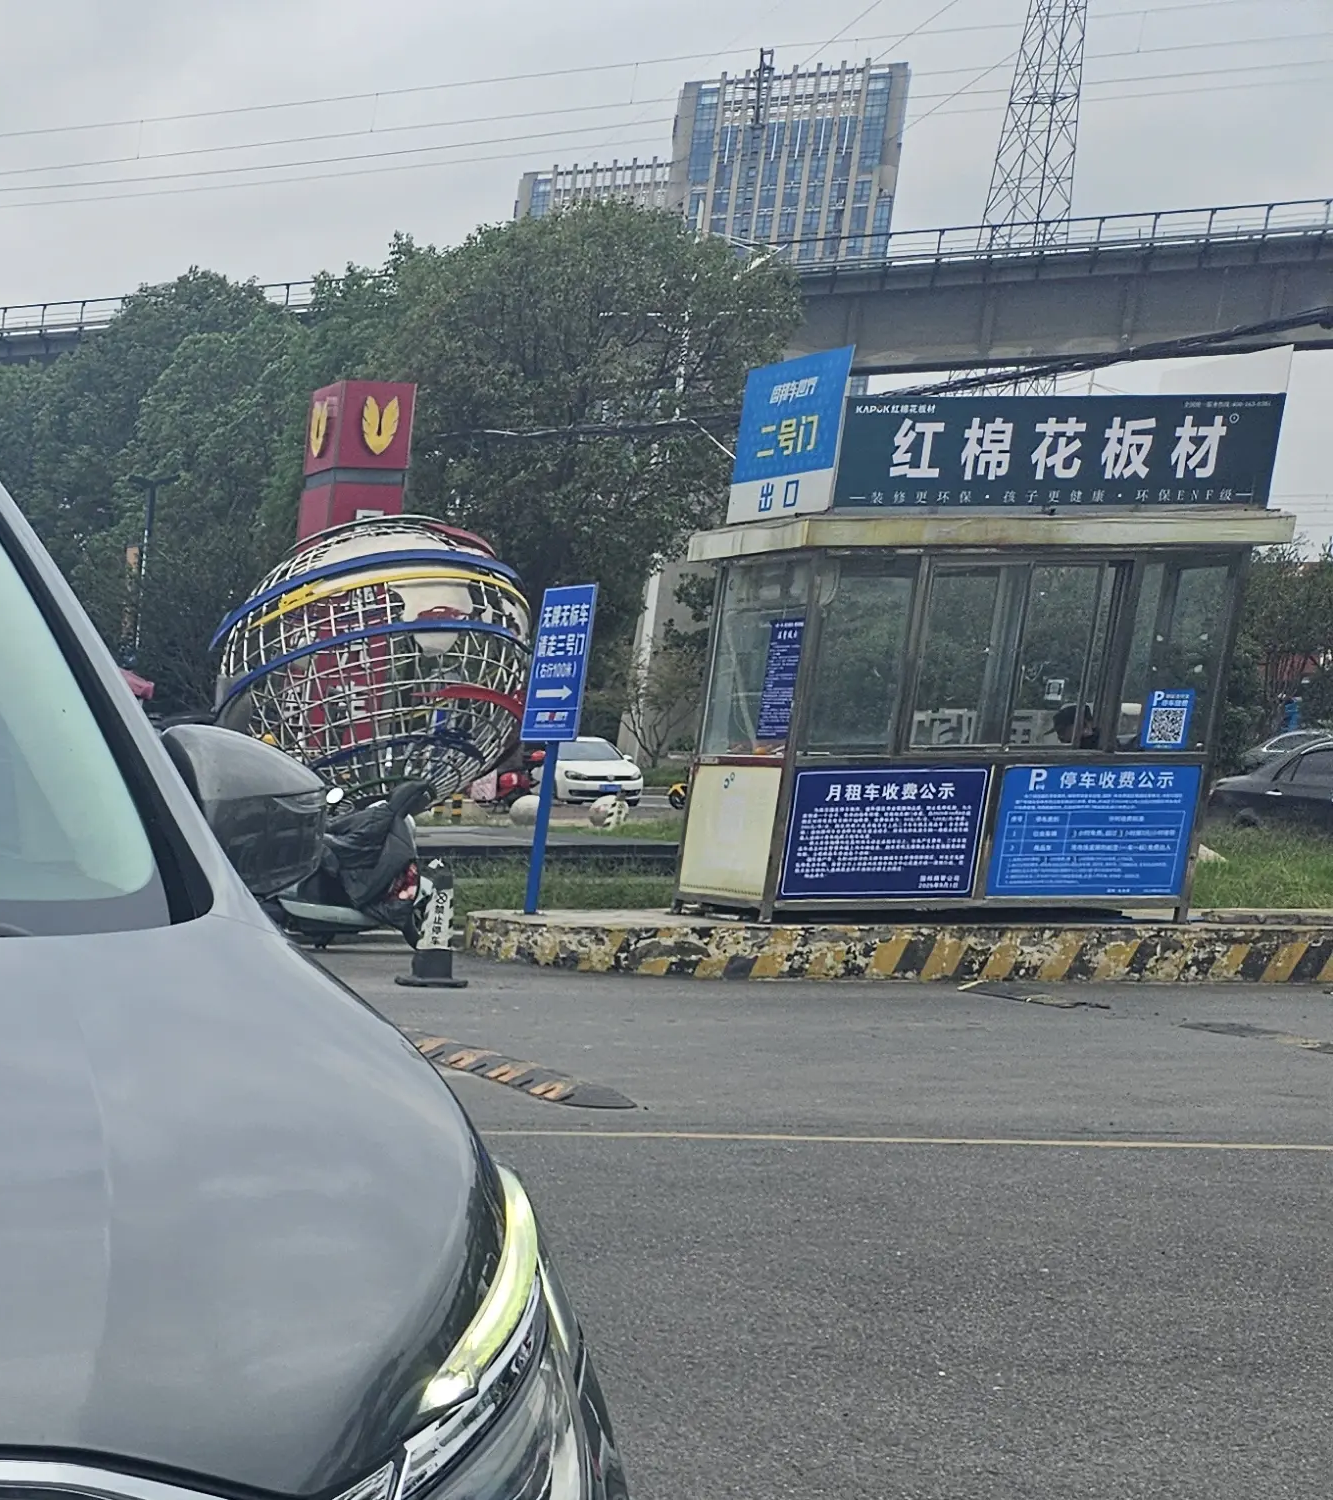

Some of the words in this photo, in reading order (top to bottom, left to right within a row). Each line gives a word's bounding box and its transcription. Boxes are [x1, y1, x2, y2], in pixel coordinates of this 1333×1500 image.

[757, 415, 818, 457] 二号门
[889, 415, 1227, 481] 红棉花板材
[758, 480, 799, 512] 出口
[537, 633, 585, 657] 请走三号门
[1029, 768, 1048, 791] P
[1060, 771, 1174, 789] 停车收费公示
[825, 783, 955, 801] 月租车收费公示
